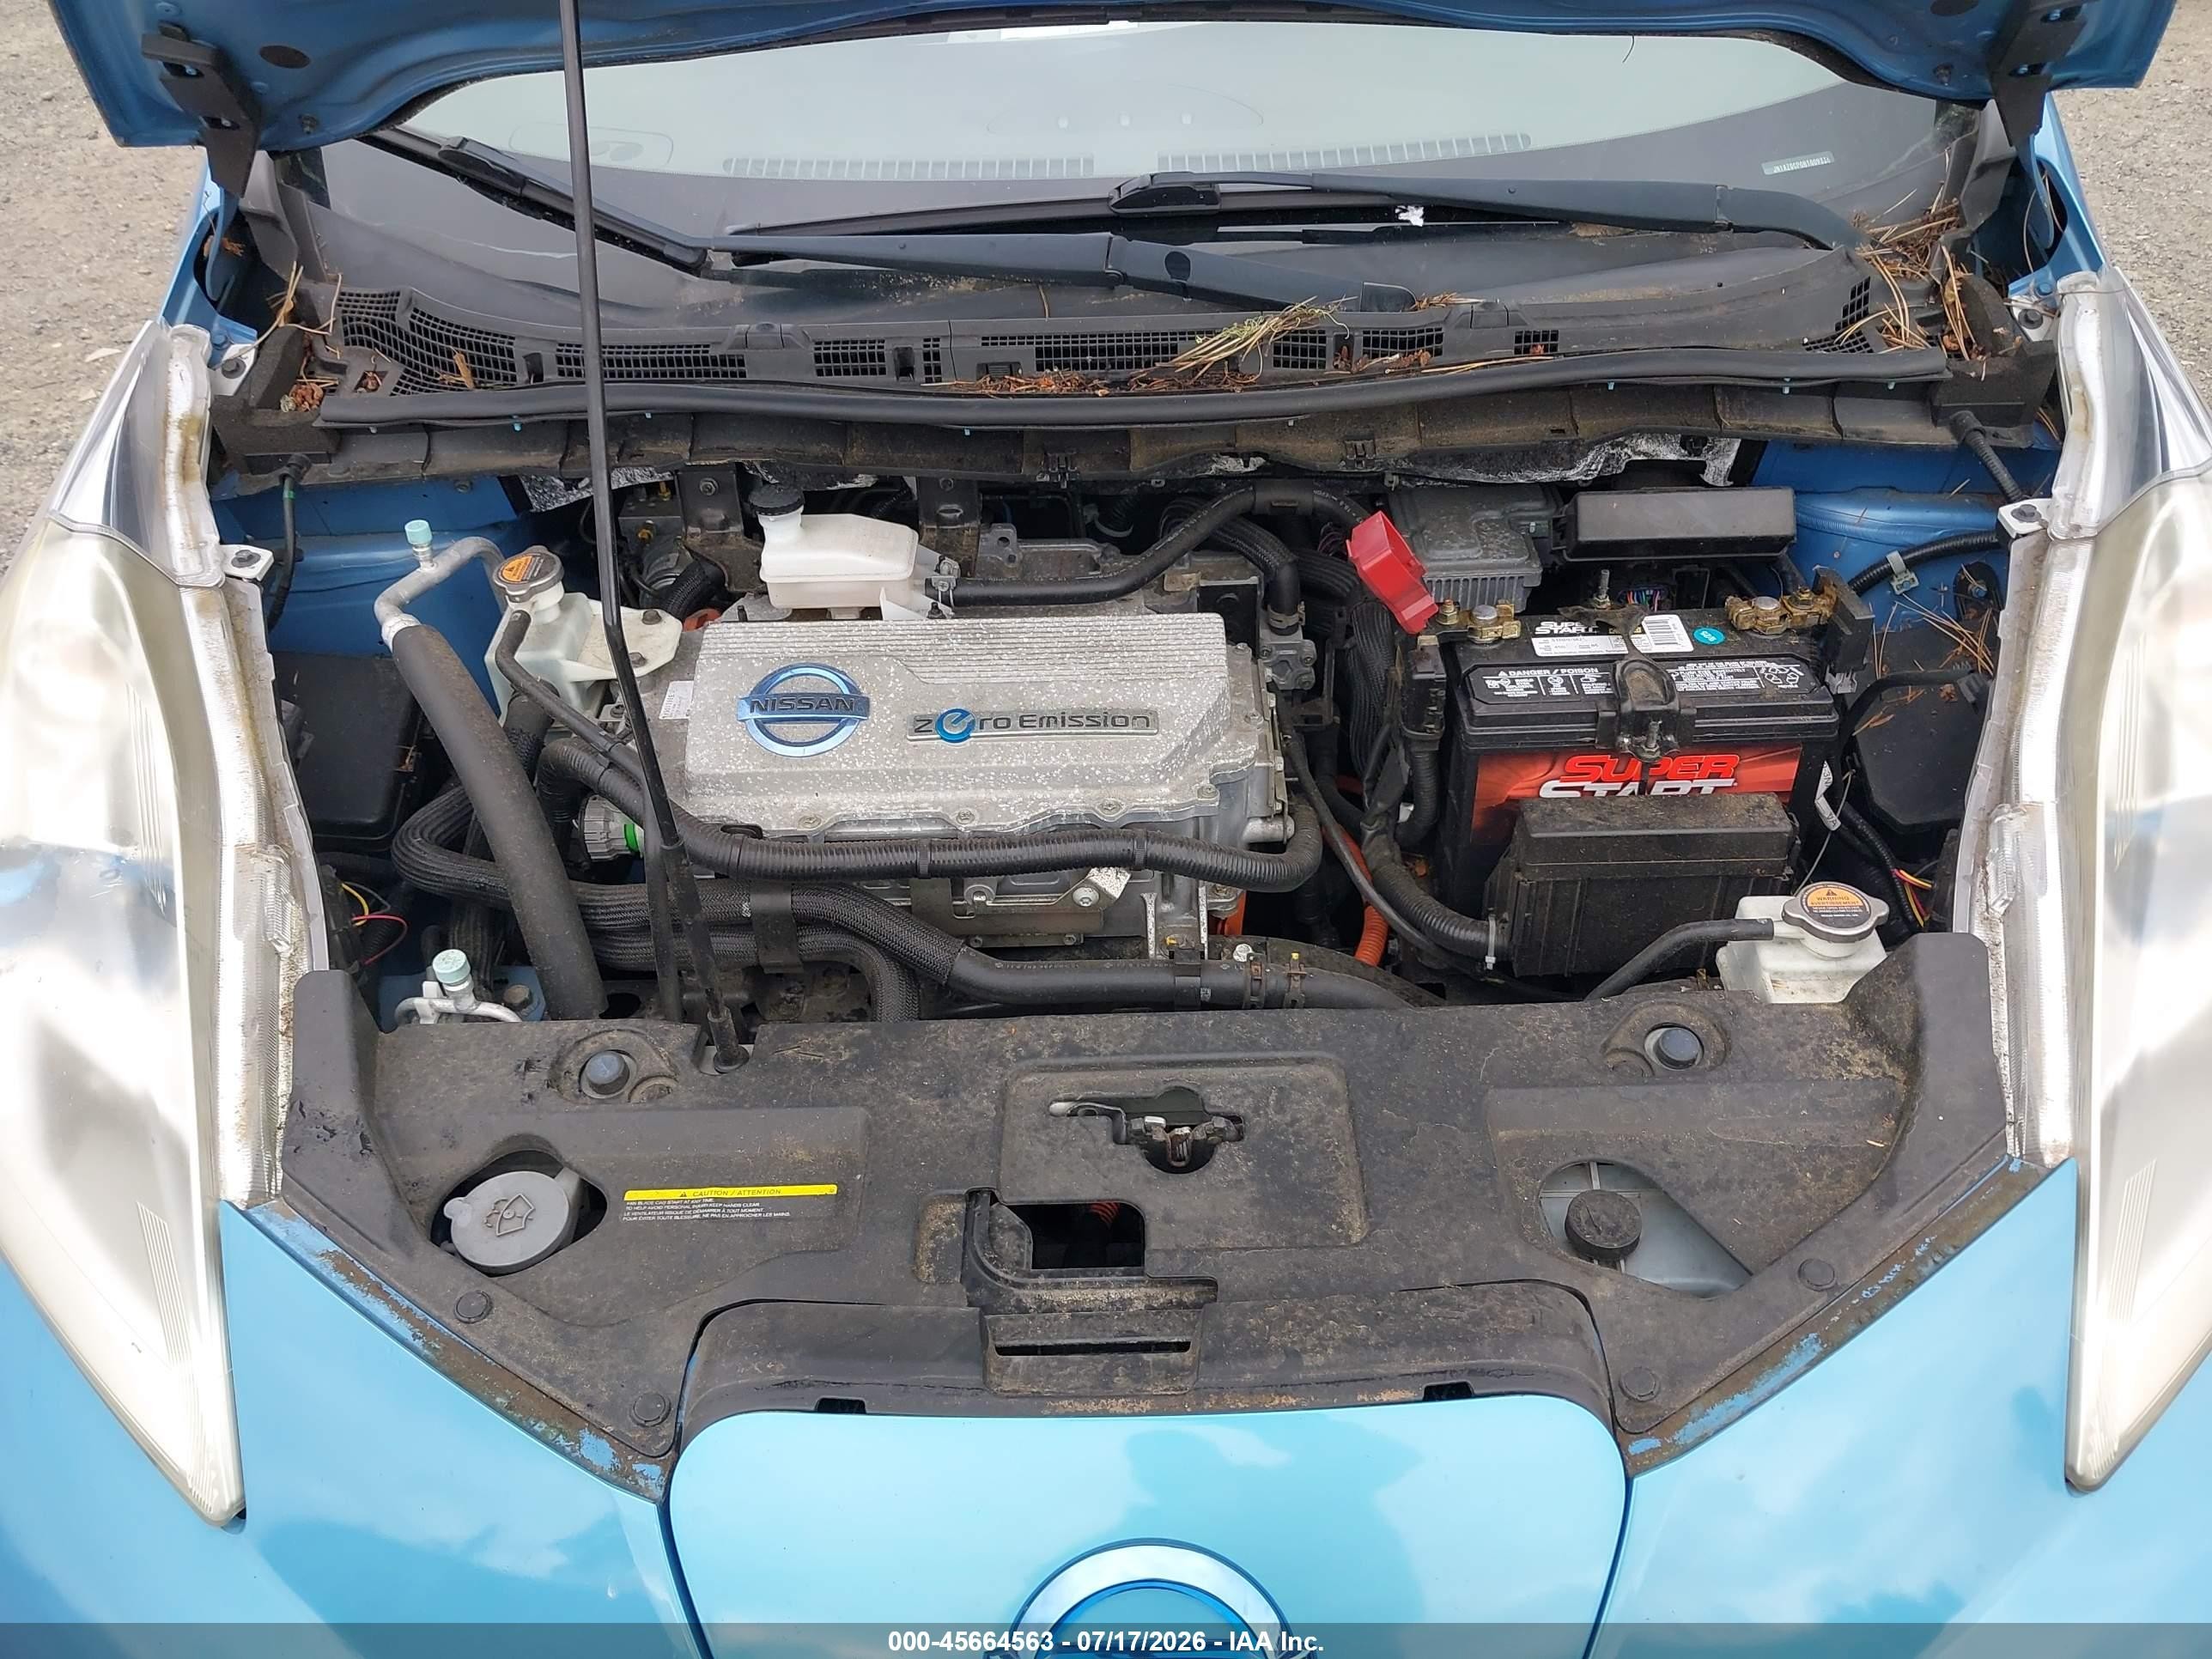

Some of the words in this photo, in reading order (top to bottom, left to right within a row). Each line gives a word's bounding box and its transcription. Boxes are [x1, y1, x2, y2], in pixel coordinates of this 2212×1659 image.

[750, 696, 854, 714] NISSAN
[914, 708, 1012, 744] zero
[1018, 711, 1151, 729] Emission
[1559, 754, 1740, 782] SUPER
